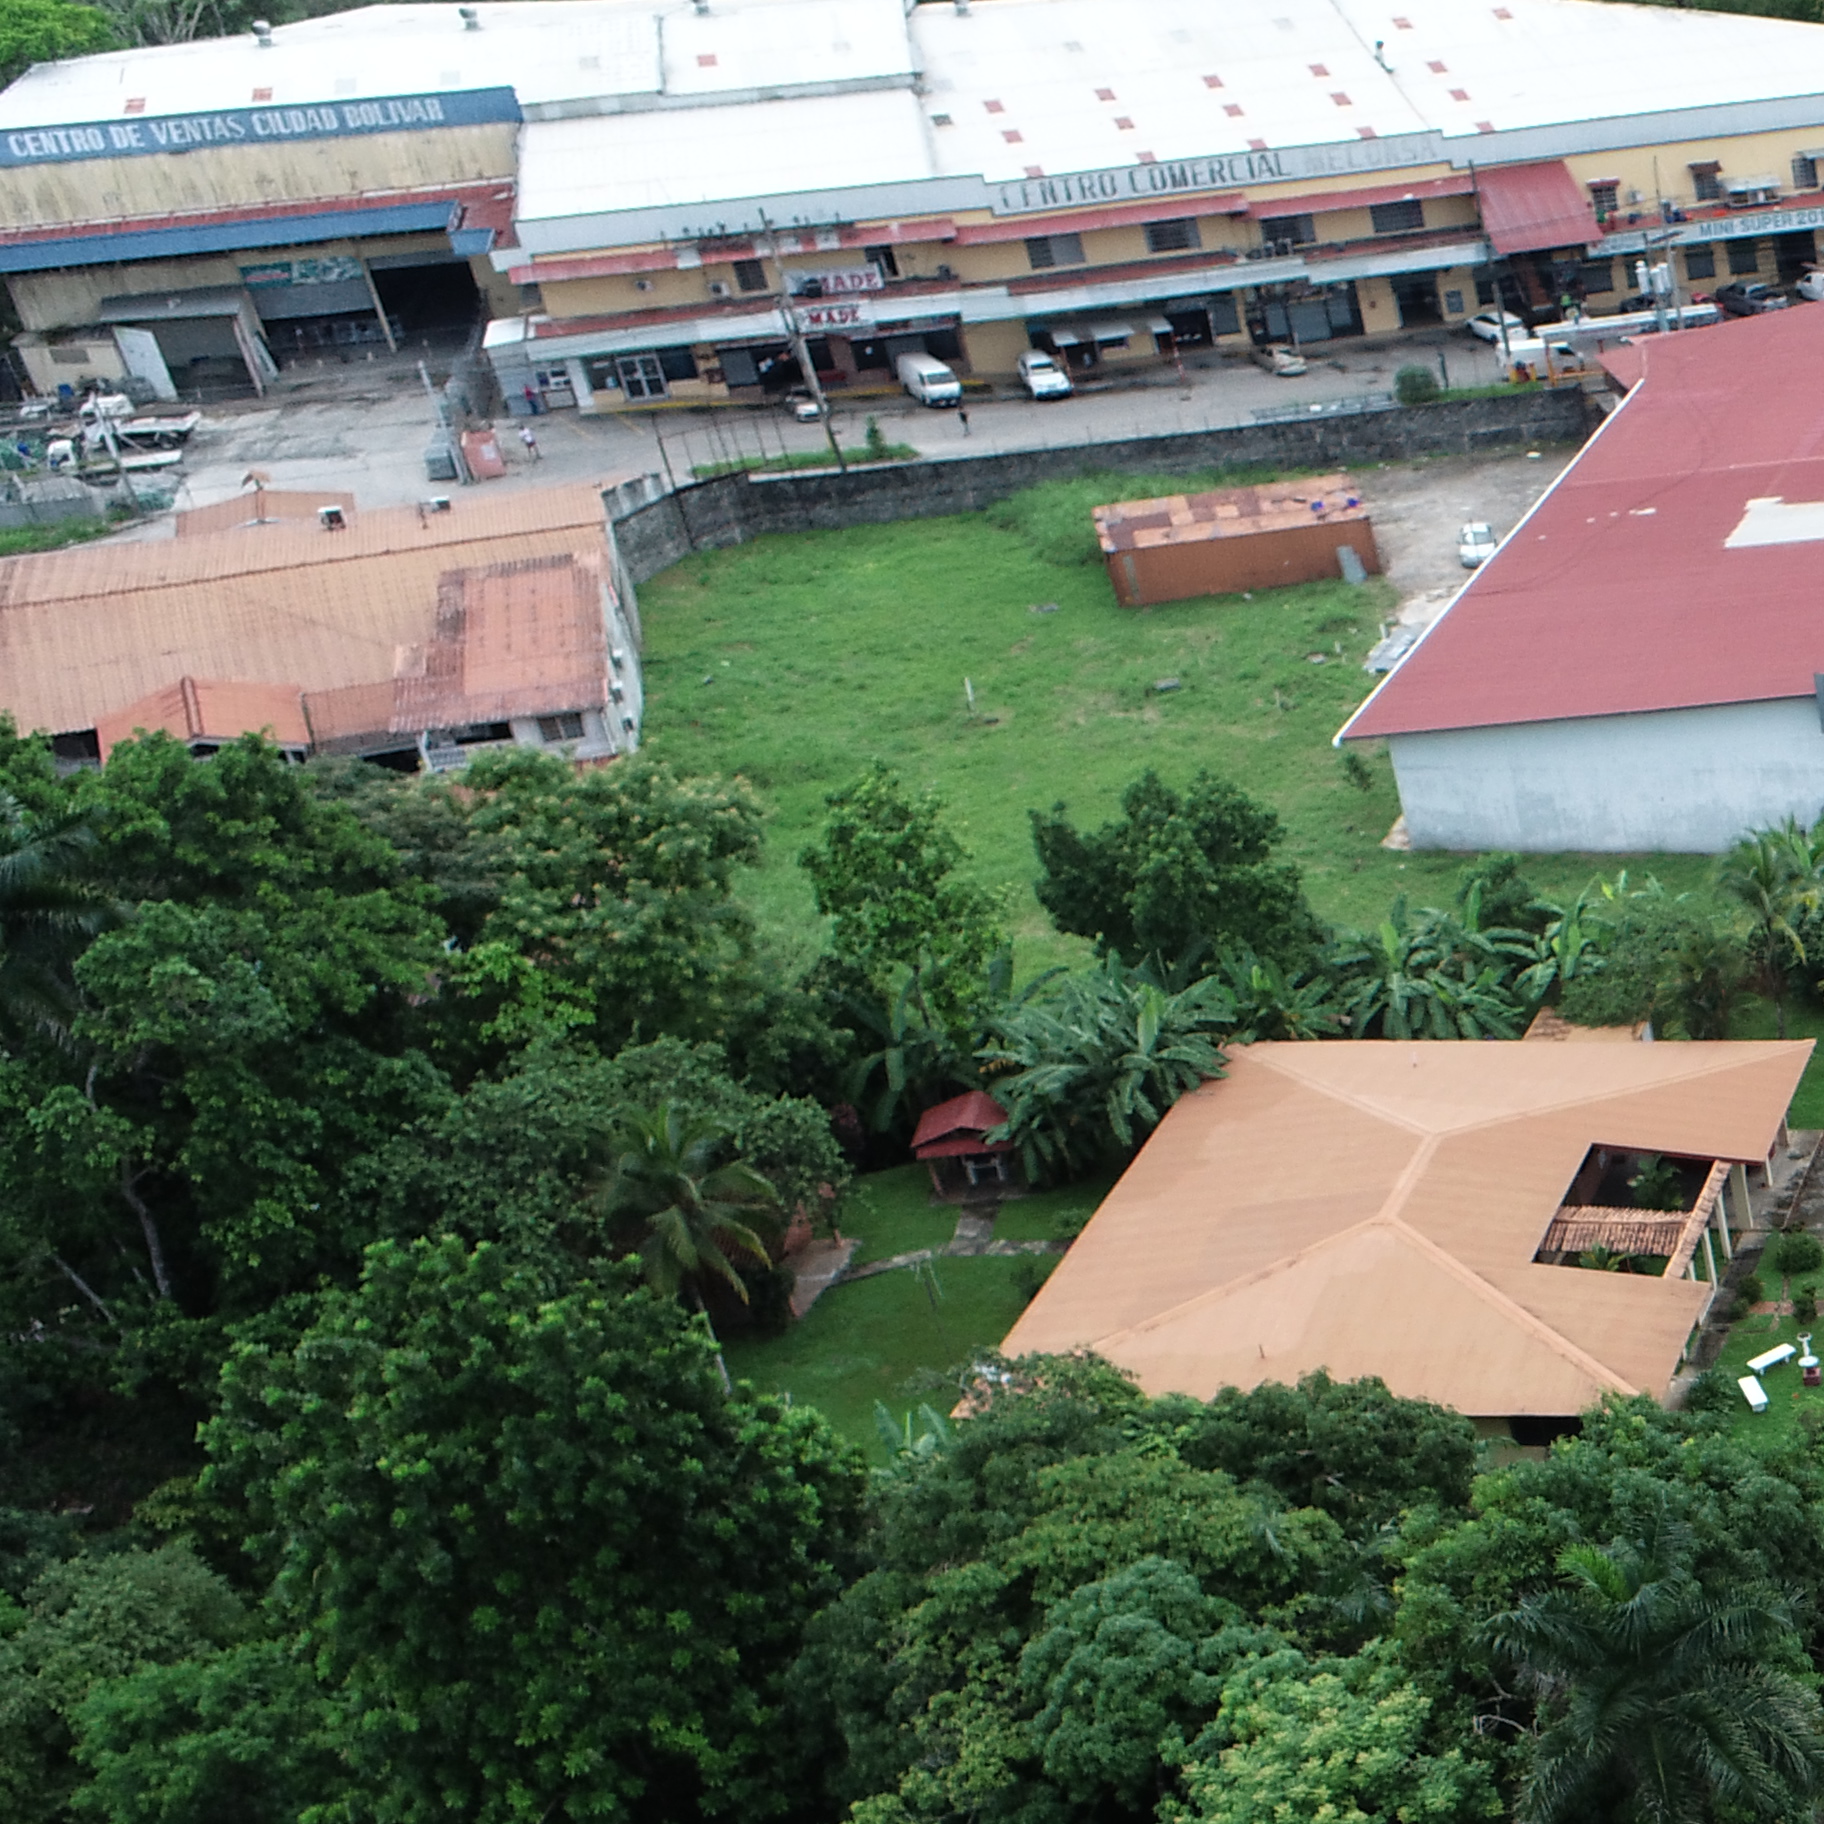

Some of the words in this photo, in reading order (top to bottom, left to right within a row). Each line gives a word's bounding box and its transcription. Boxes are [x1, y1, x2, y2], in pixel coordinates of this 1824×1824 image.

[7, 128, 105, 158] CENTRO
[108, 124, 146, 150] DE
[150, 115, 246, 145] VENTAS
[251, 107, 340, 137] CIUDAD
[343, 98, 445, 129] BOLIVAR
[999, 172, 1118, 209] CENTRO
[1128, 152, 1292, 193] COMERCIAL
[1699, 223, 1735, 238] MINI
[1740, 215, 1794, 233] SUPER
